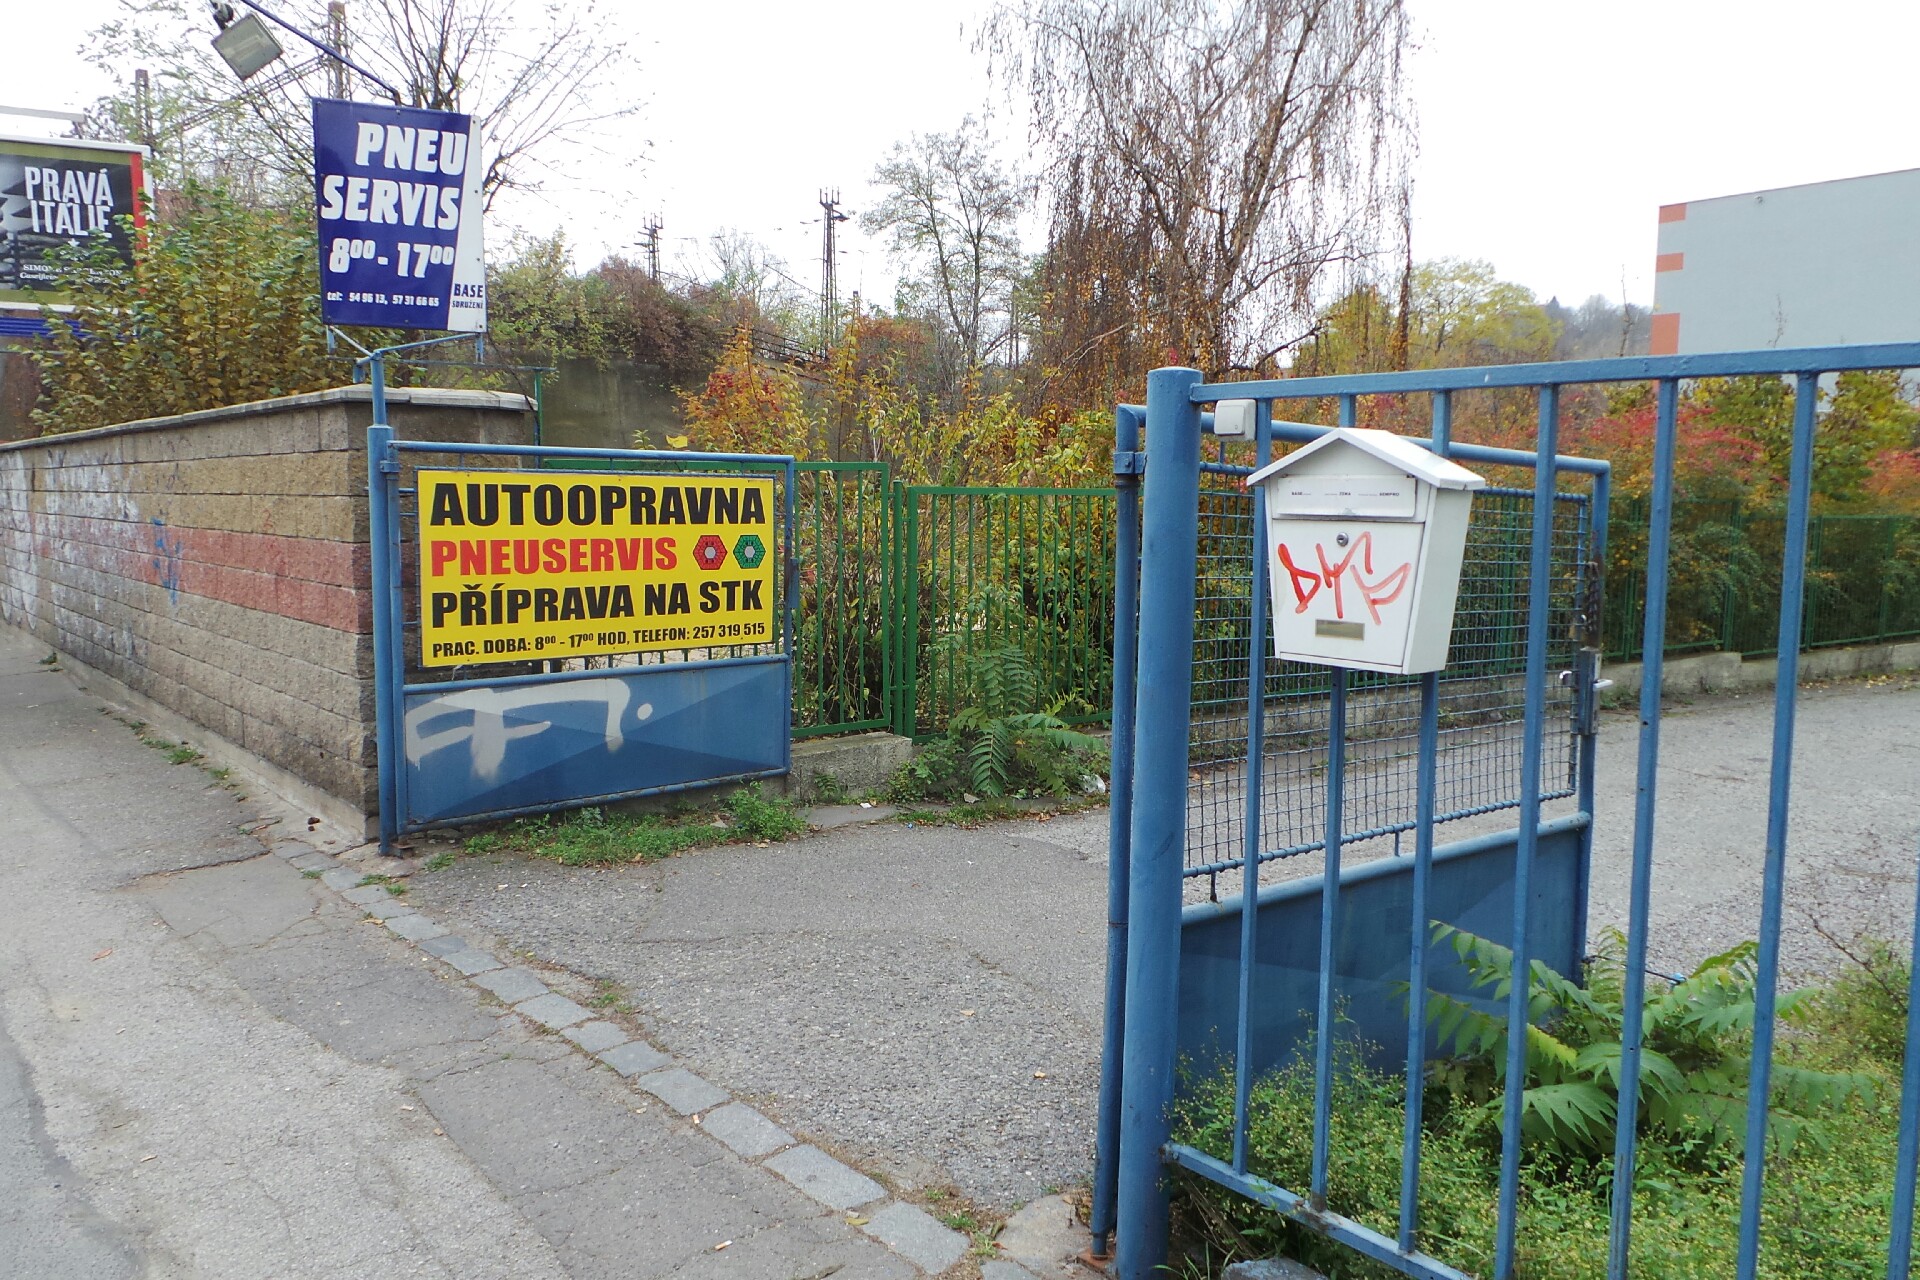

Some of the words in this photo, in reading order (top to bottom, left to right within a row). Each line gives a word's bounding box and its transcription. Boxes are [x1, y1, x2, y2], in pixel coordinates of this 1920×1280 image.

[355, 122, 468, 176] PNEU
[25, 166, 114, 207] PRAVÁ
[320, 174, 461, 231] SERVIS
[453, 283, 484, 298] BASE
[430, 482, 766, 527] AUTOOPRAVNA
[430, 537, 678, 577] PNEUSERVIS
[432, 583, 635, 629] PŘÍPRAVA
[644, 583, 691, 617] NA
[699, 579, 764, 614] STK
[432, 641, 480, 658] PRAC.
[483, 637, 531, 654] DOBA:
[597, 631, 631, 646] HOD,
[633, 627, 690, 643] TELEFON:
[692, 625, 716, 639] 257
[718, 624, 741, 637] 319
[743, 622, 765, 635] 515
